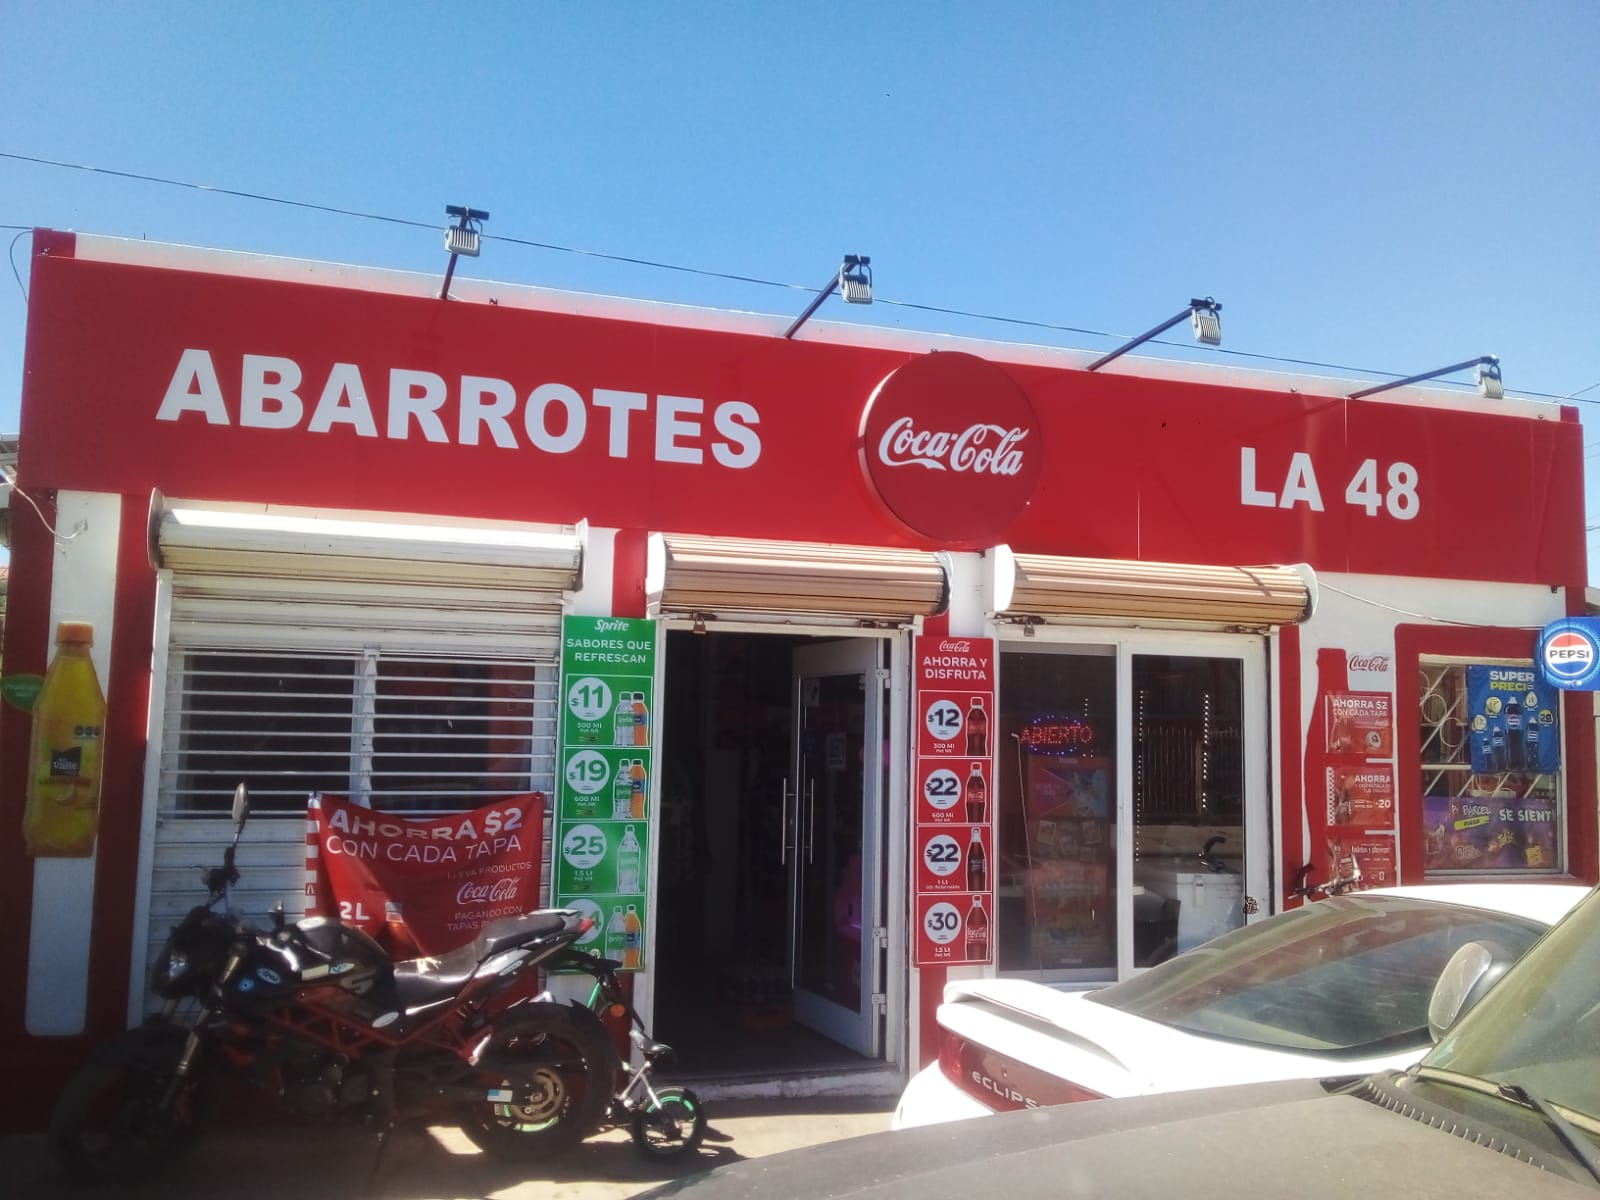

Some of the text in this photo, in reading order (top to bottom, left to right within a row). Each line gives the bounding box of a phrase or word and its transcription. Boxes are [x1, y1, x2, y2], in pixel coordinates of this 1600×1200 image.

[155, 348, 762, 469] ABARROTES
[878, 416, 1030, 476] Coca-Cola
[1240, 446, 1420, 520] LA 48
[594, 619, 630, 633] Sprite
[567, 638, 651, 650] SABORES QUE
[939, 640, 971, 653] Coca-Cola
[574, 652, 646, 664] REFRESCAN
[923, 656, 988, 668] AHORRA Y
[1549, 649, 1590, 659] PEPSI
[1349, 655, 1390, 672] Coca-Cola
[925, 668, 987, 680] DISFRUTA
[1489, 670, 1535, 682] SUPER
[571, 684, 605, 709] $11
[1333, 699, 1375, 709] AHORRA
[928, 708, 960, 727] $12
[1333, 708, 1348, 716] CON
[1349, 708, 1369, 717] CADA
[1021, 726, 1094, 744] ABIERTO
[569, 759, 607, 782] $19
[1355, 774, 1391, 783] AHORRA
[926, 777, 958, 796] $22
[1499, 807, 1514, 821] SE
[330, 807, 523, 840] AHORRA $2
[326, 834, 522, 864] CON CADA TAPA
[564, 836, 604, 856] $25
[926, 843, 959, 863] $22
[480, 861, 532, 876] PRODUCTOS
[456, 877, 521, 905] Coca-Cola
[455, 905, 523, 921] PAGANDO CON
[928, 911, 959, 931] $30
[448, 920, 479, 931] TAPAS
[972, 1071, 1038, 1109] ECLIPS
